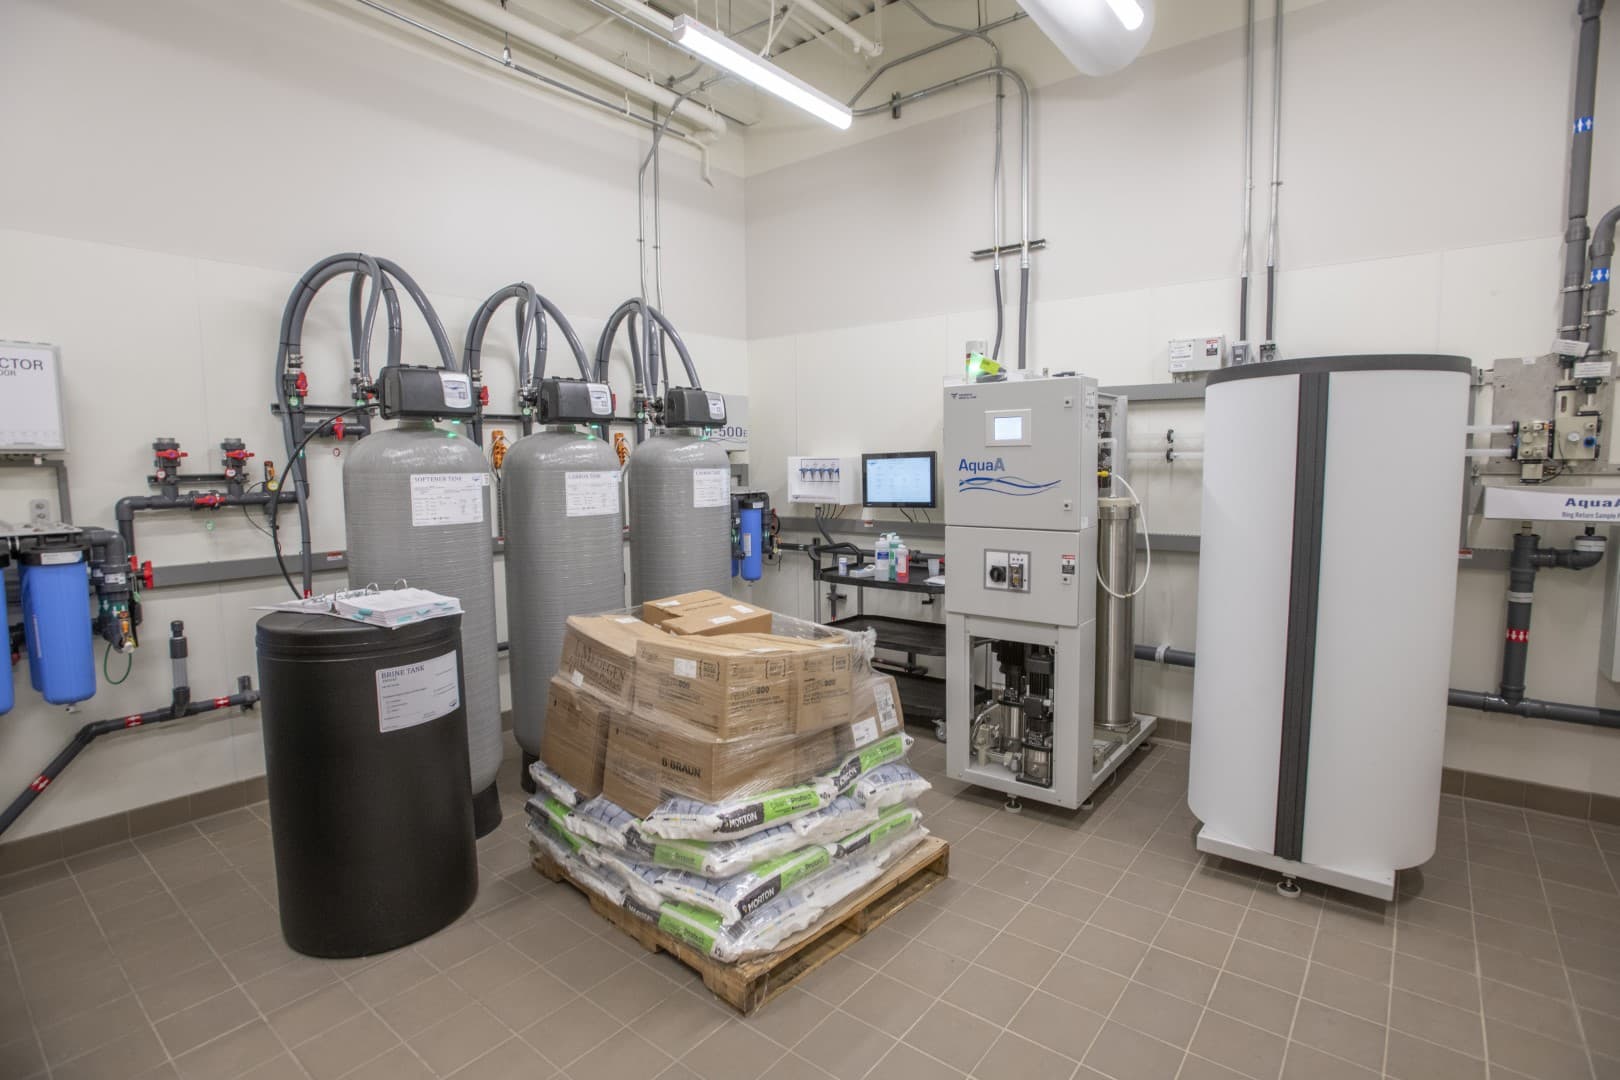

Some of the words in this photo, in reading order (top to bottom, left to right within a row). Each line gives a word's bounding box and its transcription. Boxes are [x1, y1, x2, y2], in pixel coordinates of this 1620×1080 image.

[958, 457, 1006, 475] AquaA
[381, 669, 405, 679] BRINE
[407, 664, 425, 675] TANK
[669, 760, 702, 778] BRAUN
[729, 811, 758, 829] MORTON
[747, 887, 776, 912] MORTON
